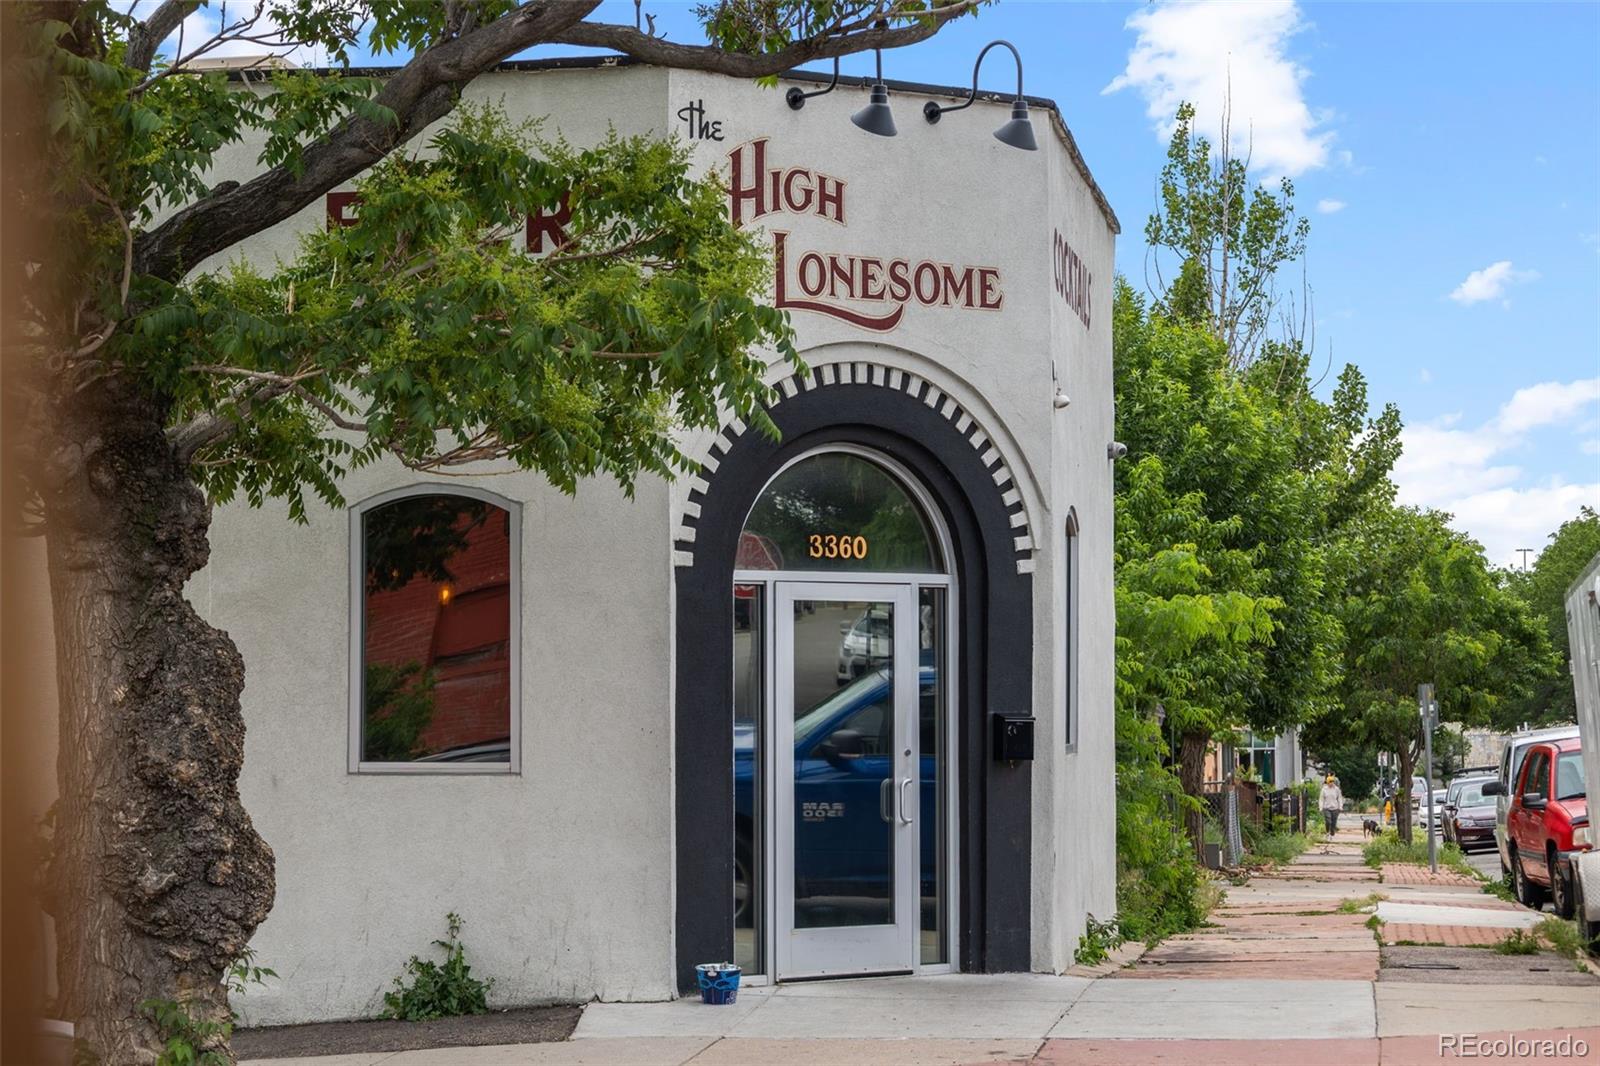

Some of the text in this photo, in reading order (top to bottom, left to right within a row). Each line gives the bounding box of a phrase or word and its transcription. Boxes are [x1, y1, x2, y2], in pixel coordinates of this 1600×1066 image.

[770, 229, 1005, 333] LONESOME
[1053, 226, 1092, 331] COCKTAILS
[809, 534, 868, 560] 3360
